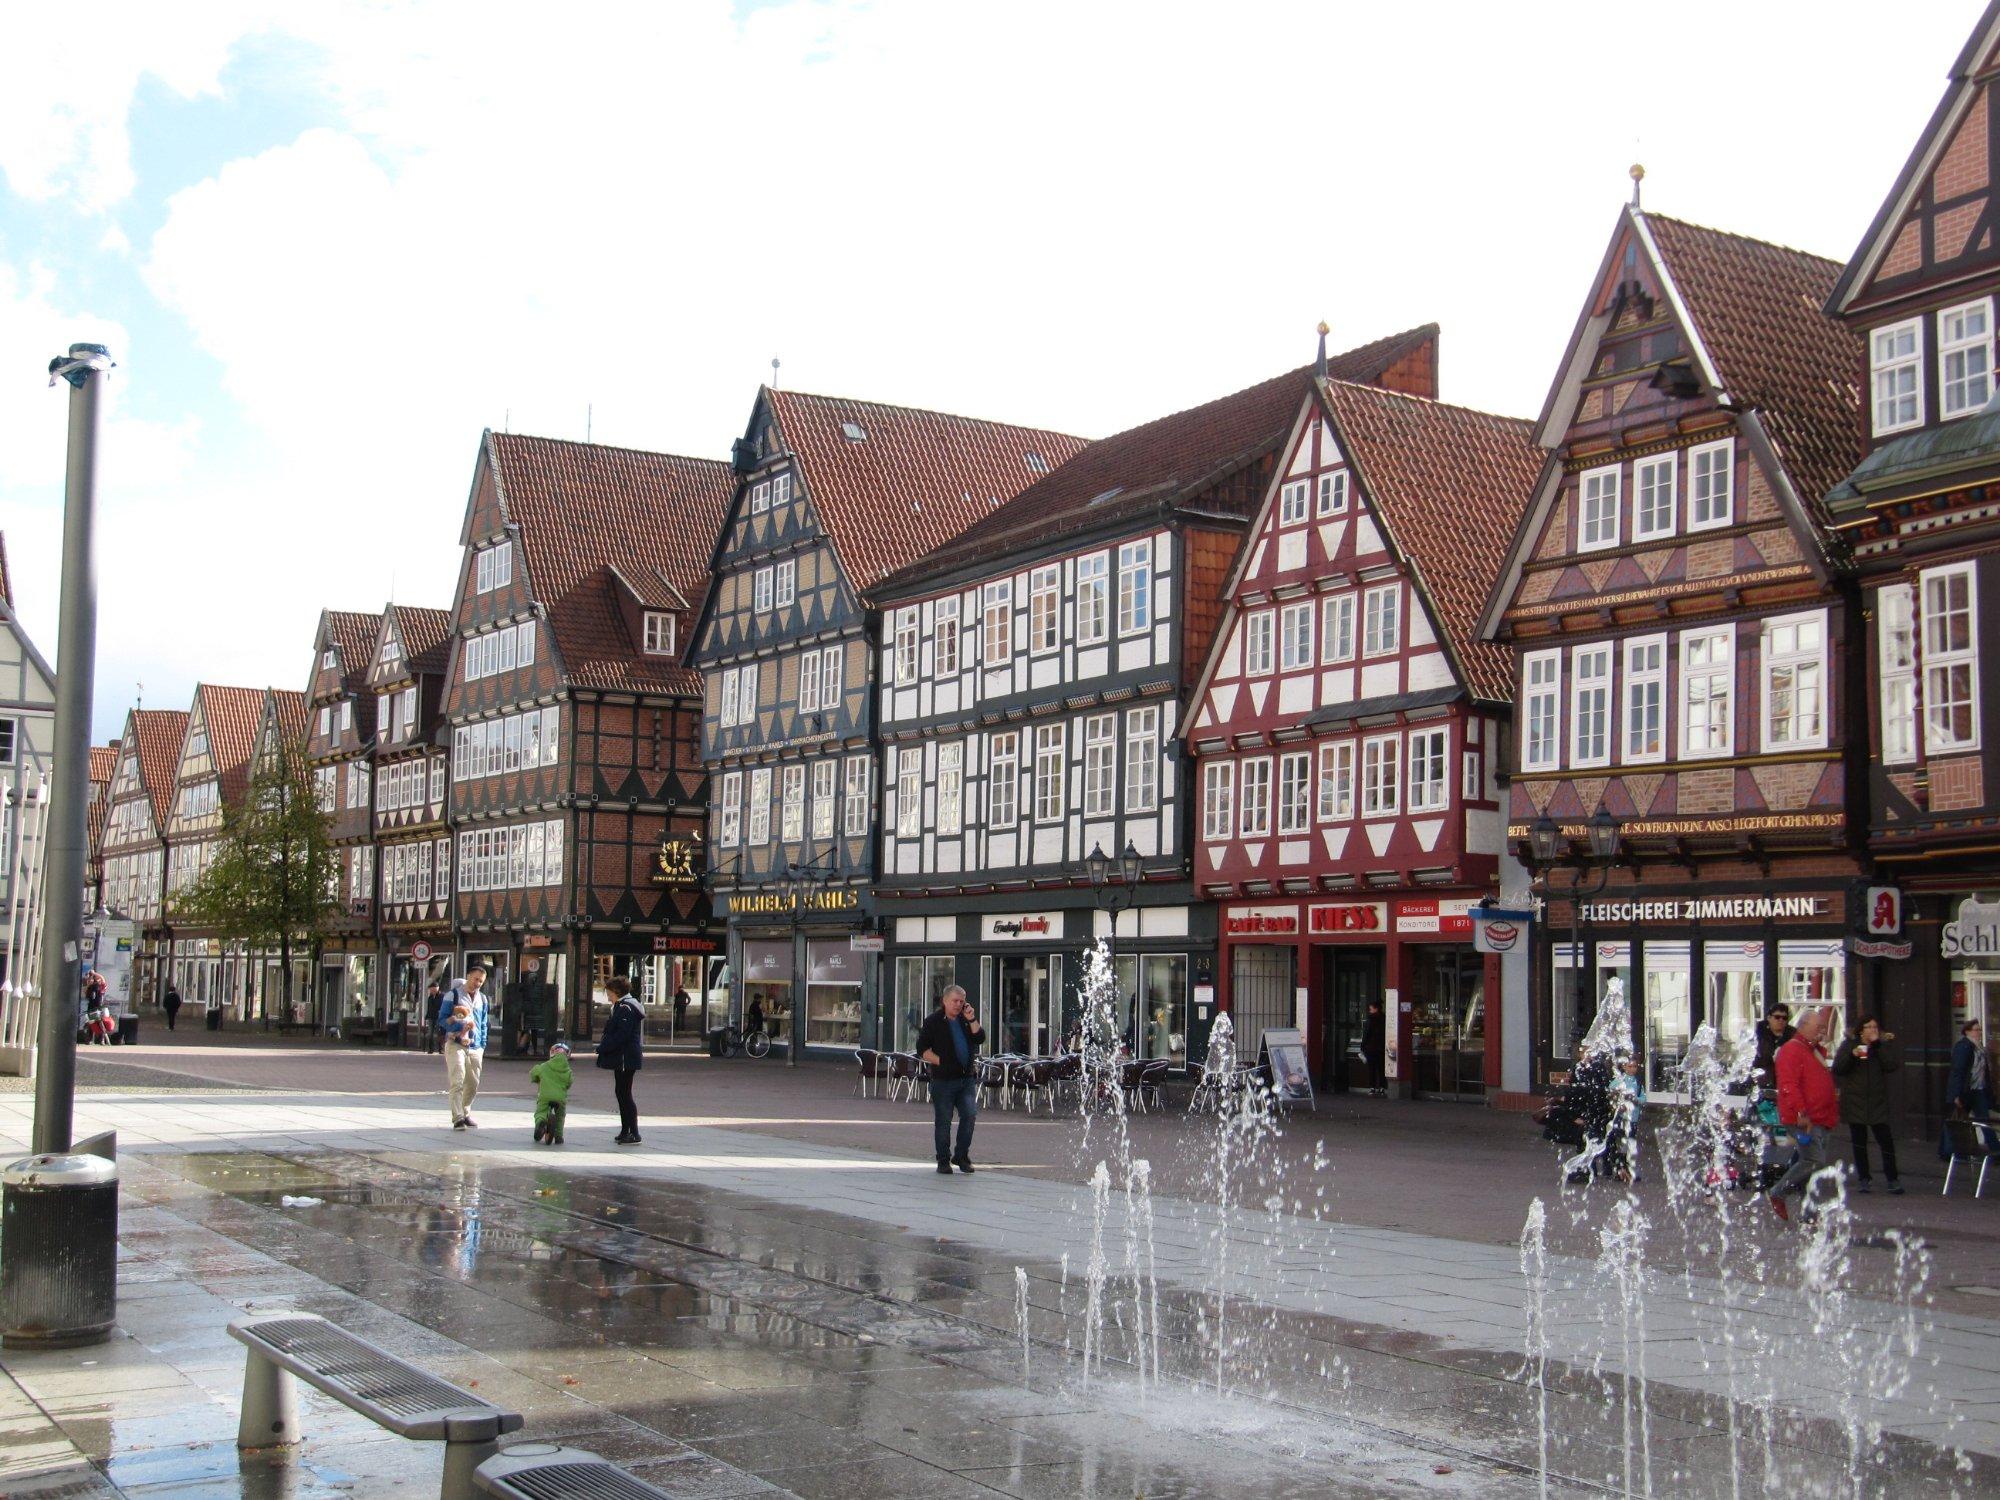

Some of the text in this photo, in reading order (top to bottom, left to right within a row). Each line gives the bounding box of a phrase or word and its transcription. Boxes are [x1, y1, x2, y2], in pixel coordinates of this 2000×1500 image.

[1402, 905, 1434, 913] BÄCKEREI
[1580, 897, 1814, 922] FLEISCHEREI ZIMMERMANN
[1312, 905, 1379, 931] KIESS
[1453, 919, 1470, 927] 1871
[1399, 920, 1437, 928] KONDITOREI
[669, 937, 716, 951] Müller
